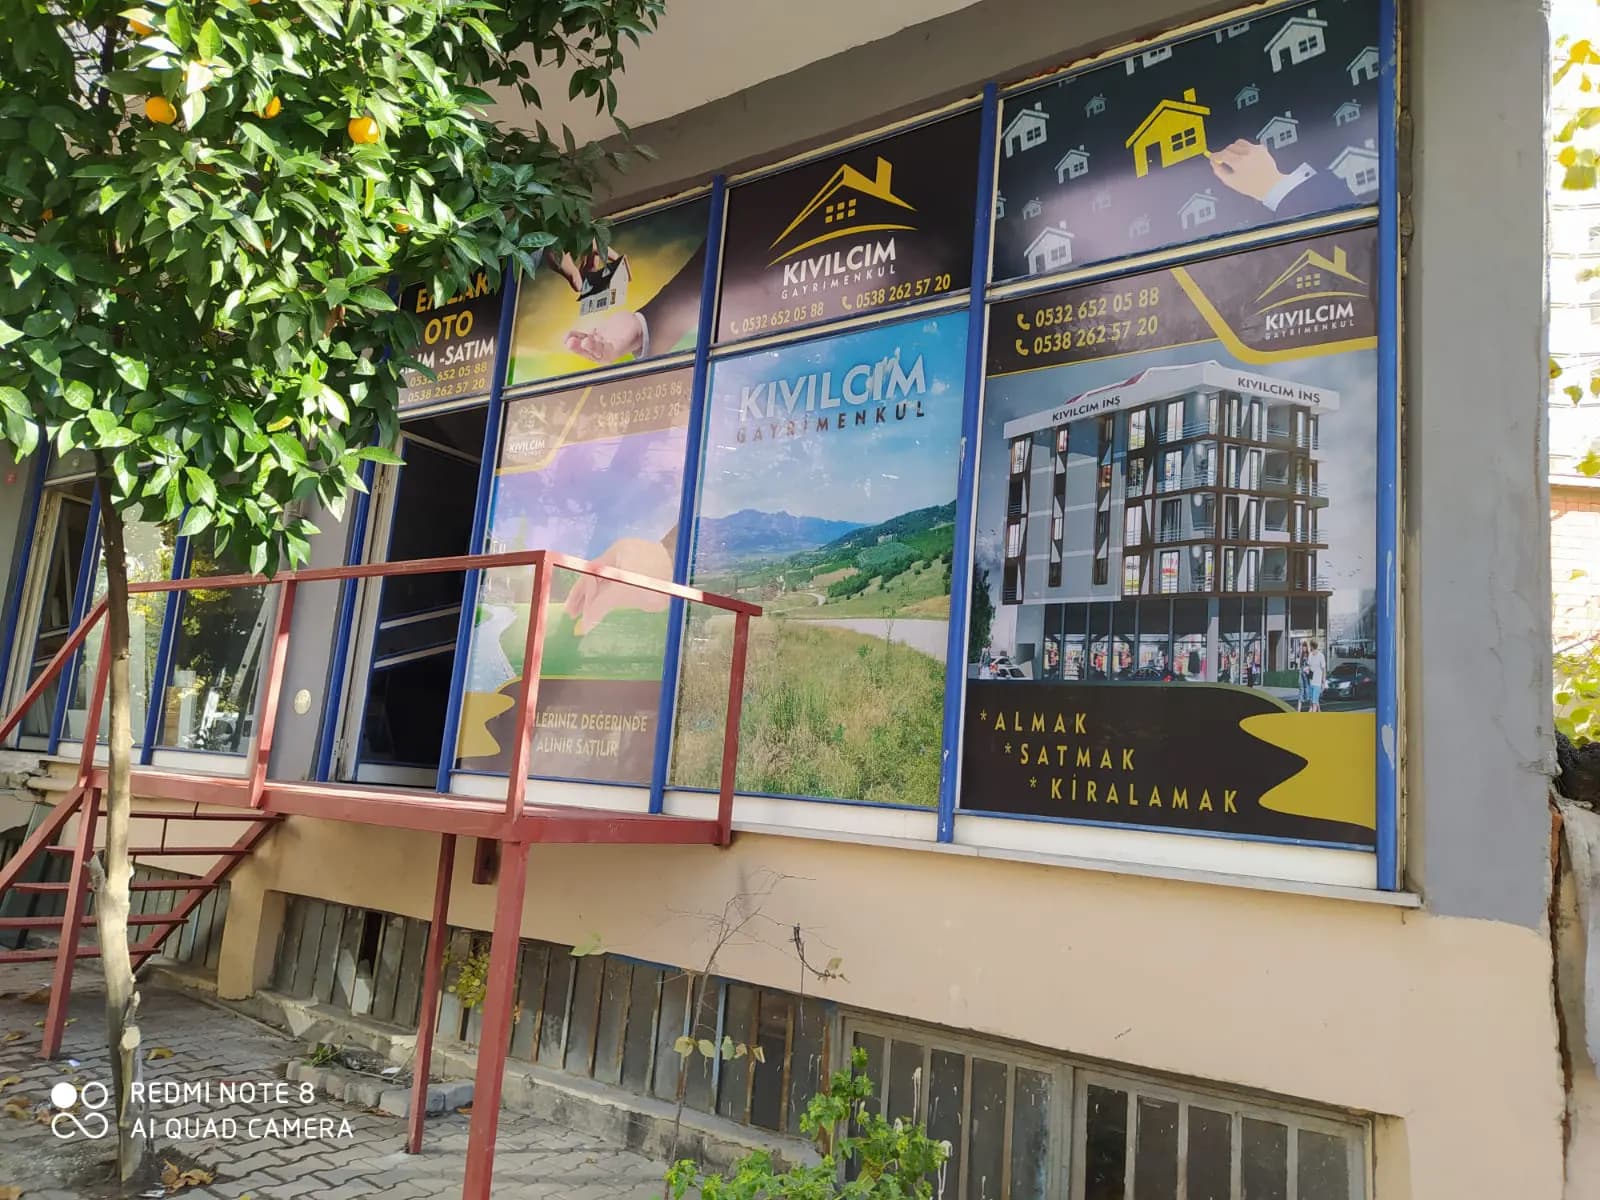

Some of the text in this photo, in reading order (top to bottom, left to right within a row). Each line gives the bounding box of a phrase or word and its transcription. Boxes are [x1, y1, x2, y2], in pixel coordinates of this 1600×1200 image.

[783, 236, 897, 287] KIVILCIM
[416, 271, 490, 313] EAK
[856, 274, 951, 309] 0538 262 57 20
[1035, 287, 1160, 328] 0532 652 05 88
[424, 310, 474, 345] OTO
[742, 302, 824, 334] 0532 652 05 88
[1265, 301, 1355, 331] KIVILCIM
[1033, 315, 1158, 354] 0538 262 57 20
[400, 350, 435, 375] IM
[437, 368, 456, 382] 652
[458, 365, 471, 377] 05
[473, 361, 488, 373] 88
[408, 378, 485, 402] 0538 262 57 20
[740, 352, 927, 423] KIVILCIM
[1238, 377, 1294, 399] KIVILCIM
[1052, 402, 1099, 422] KIVILCIM
[1051, 772, 1239, 814] KİRALAMAK
